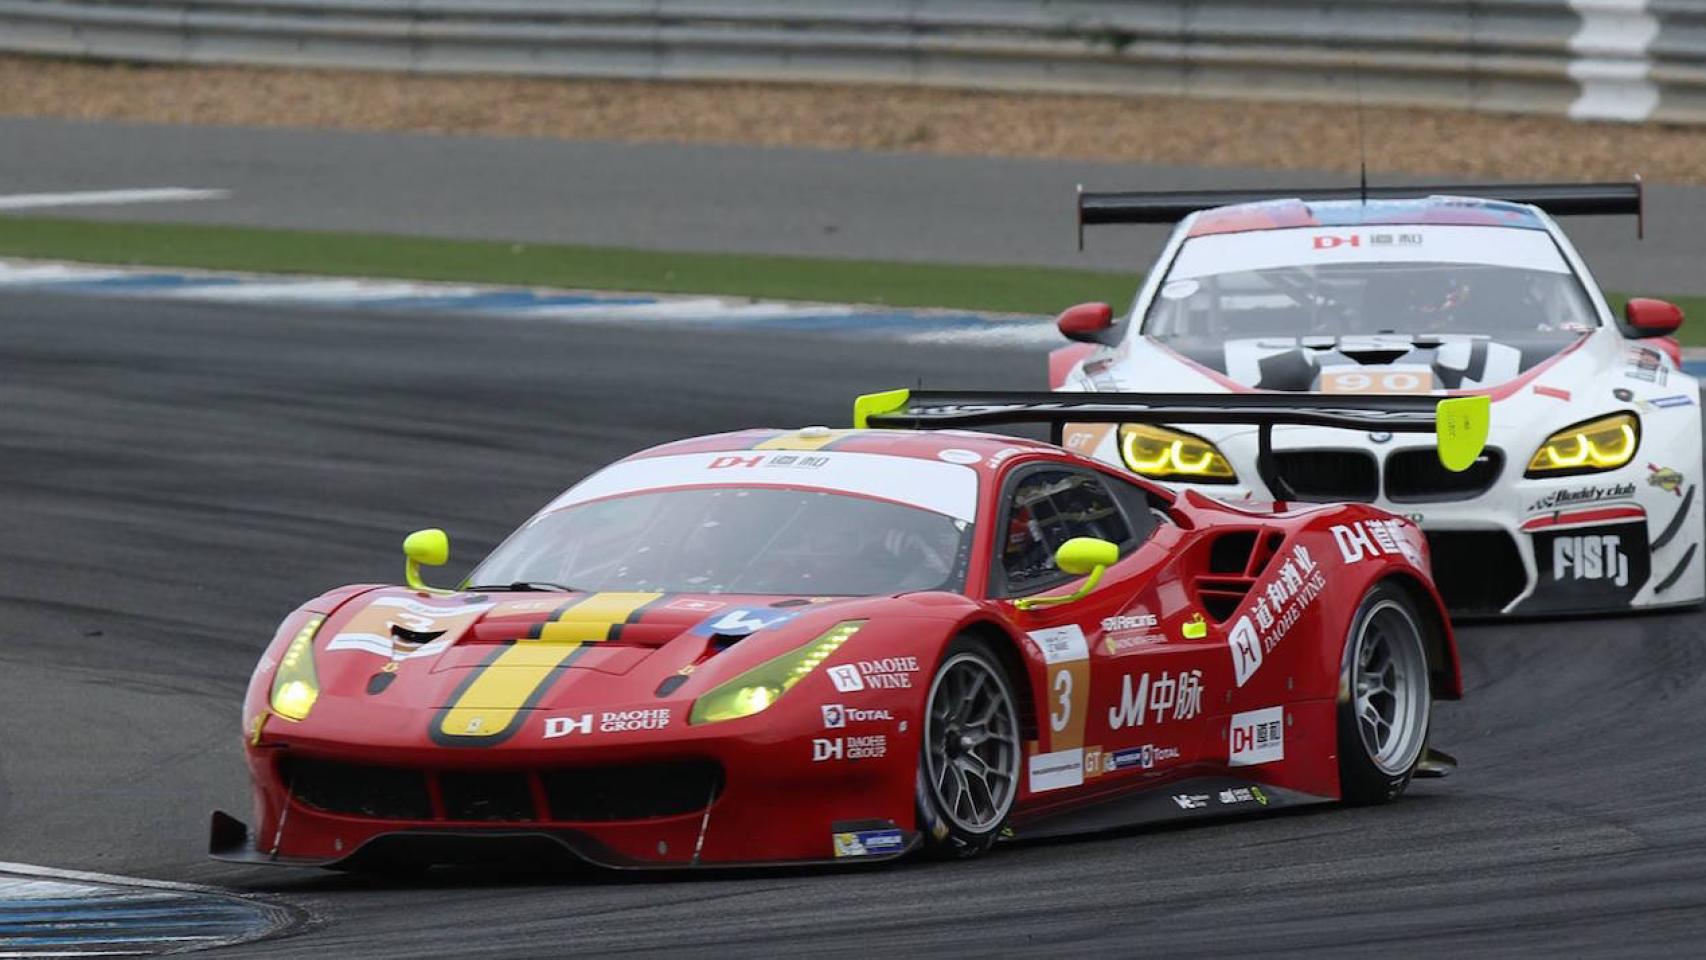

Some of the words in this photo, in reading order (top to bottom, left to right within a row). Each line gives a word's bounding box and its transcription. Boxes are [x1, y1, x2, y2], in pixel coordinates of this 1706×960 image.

[1313, 235, 1359, 249] DH
[1334, 372, 1419, 391] 90
[707, 455, 765, 469] DH
[1554, 486, 1605, 502] Buddy
[1606, 483, 1636, 497] club
[1329, 521, 1380, 564] DH
[1264, 603, 1301, 655] DAOHE
[1295, 569, 1327, 611] WINE
[858, 657, 920, 675] DAOHE
[864, 673, 912, 689] WINE
[1051, 670, 1073, 732] 3
[601, 709, 670, 722] DAOHE
[845, 708, 894, 721] TOTAL
[543, 714, 593, 739] DH
[600, 719, 669, 732] GROUP
[847, 735, 886, 747] DAOHE
[1233, 725, 1254, 754] DH
[813, 738, 843, 761] DH
[847, 747, 886, 759] GROUP
[1085, 752, 1101, 773] GT
